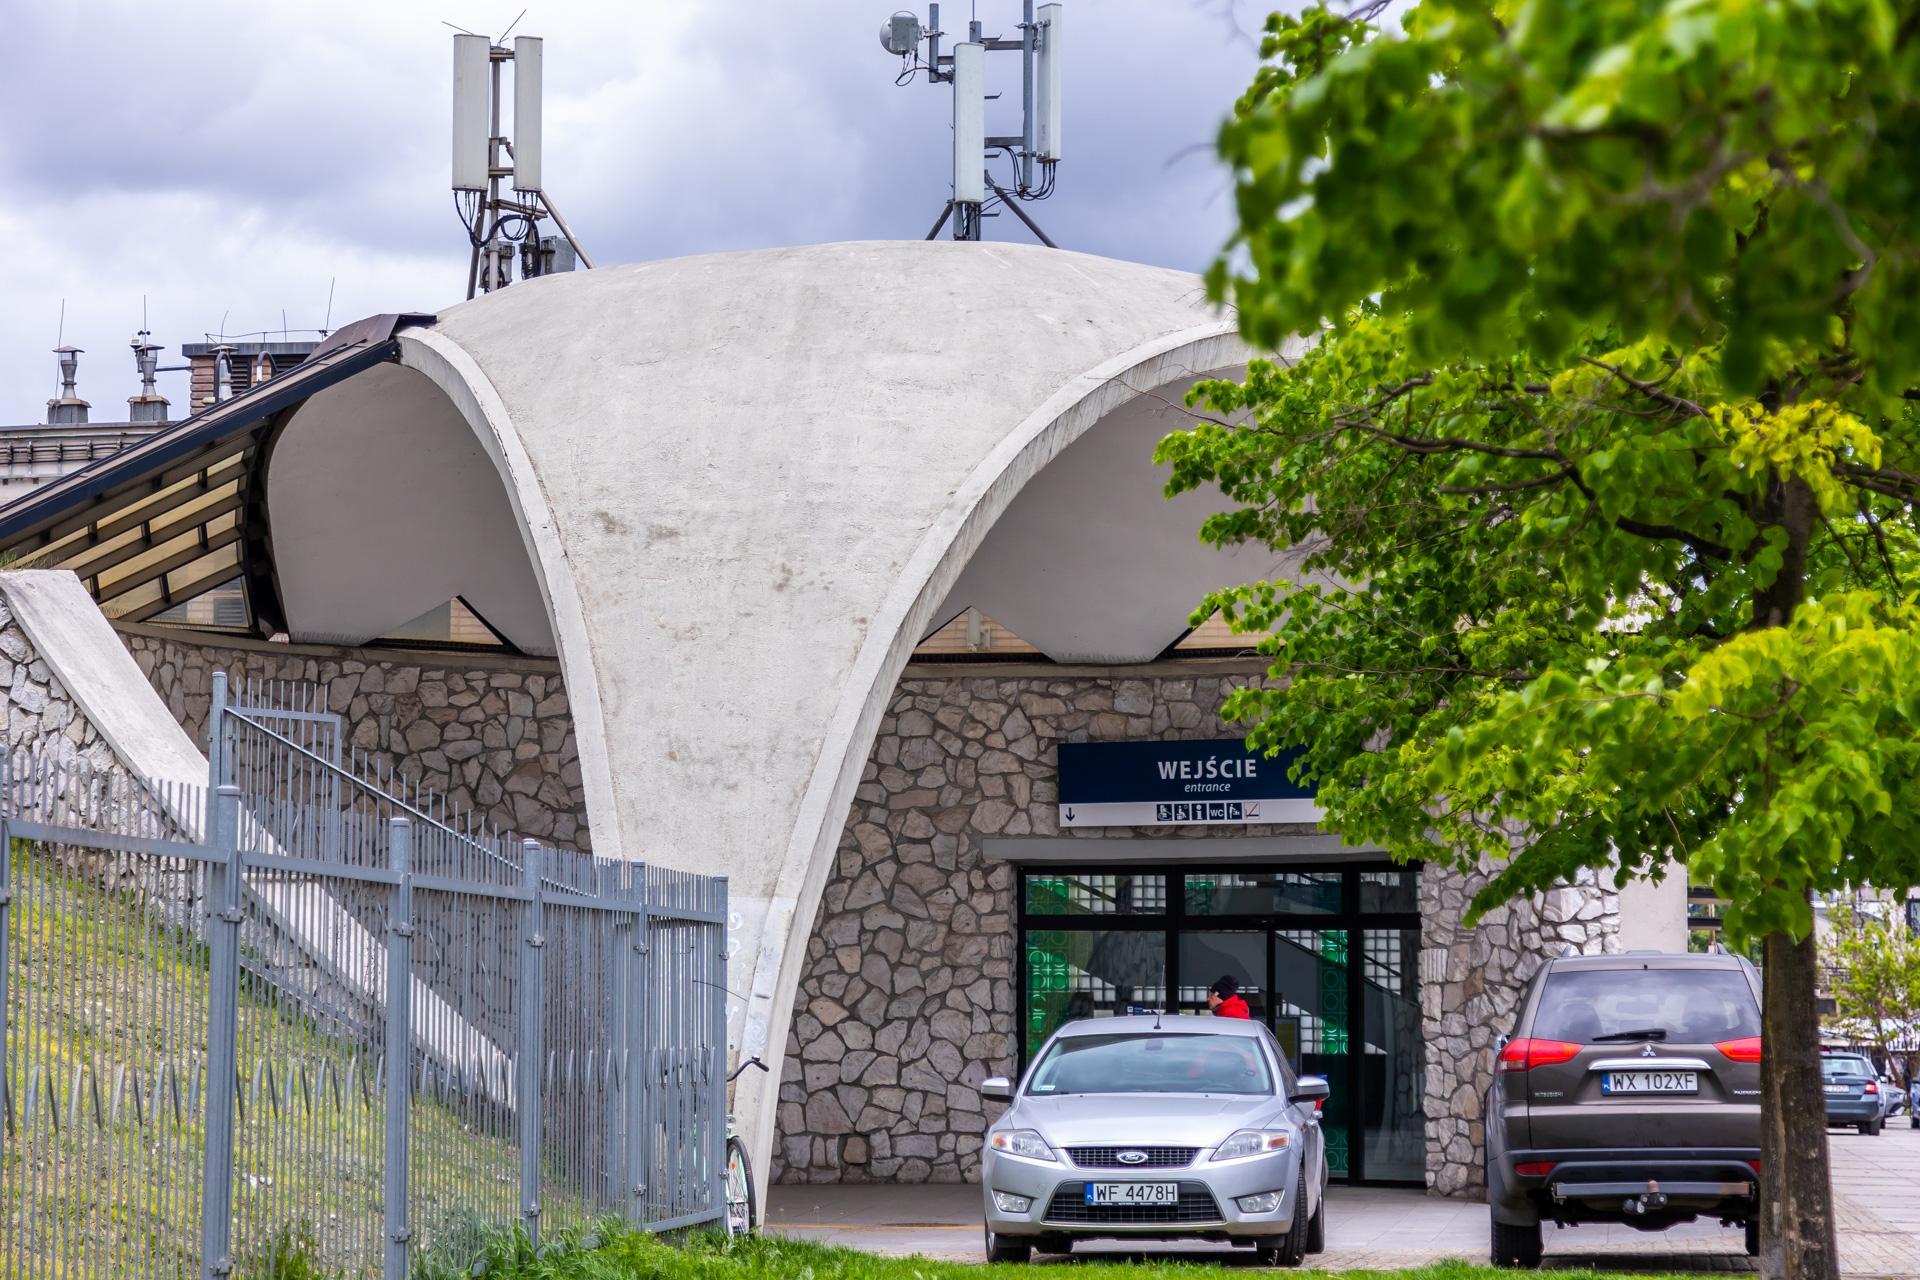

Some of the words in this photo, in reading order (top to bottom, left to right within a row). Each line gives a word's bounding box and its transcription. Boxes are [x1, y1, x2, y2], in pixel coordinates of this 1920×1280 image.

[1157, 756, 1257, 779] WEJŚCIE
[1184, 783, 1231, 792] entrance
[1210, 809, 1224, 817] WC
[1613, 1074, 1637, 1090] WX
[1645, 1073, 1695, 1090] 102XF
[1096, 1185, 1119, 1201] WF
[1125, 1185, 1176, 1201] 4478H
